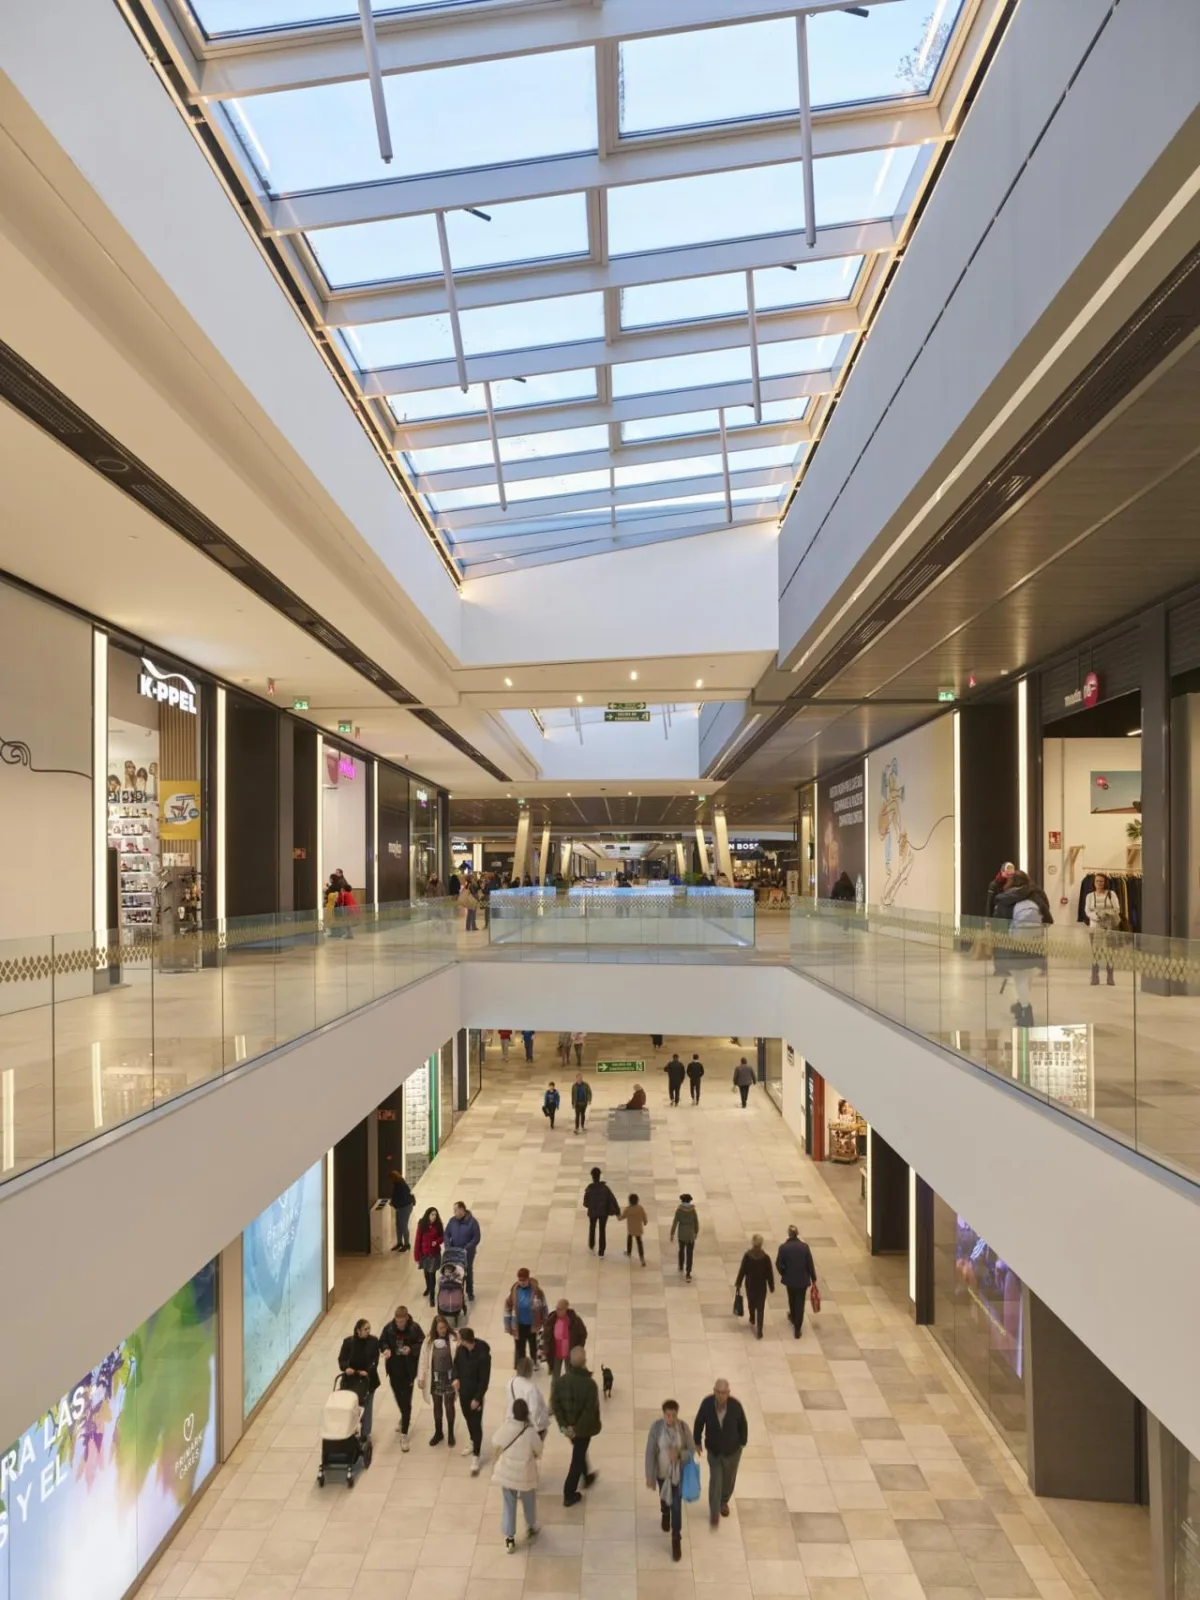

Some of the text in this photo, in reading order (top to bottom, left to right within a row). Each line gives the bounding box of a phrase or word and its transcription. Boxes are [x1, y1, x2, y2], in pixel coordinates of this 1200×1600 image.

[140, 674, 197, 715] K-PPEL
[43, 1385, 86, 1451] LAS
[174, 1428, 204, 1475] PRIMARK
[179, 1448, 199, 1480] CARES
[16, 1482, 32, 1523] Y
[40, 1454, 68, 1503] EL
